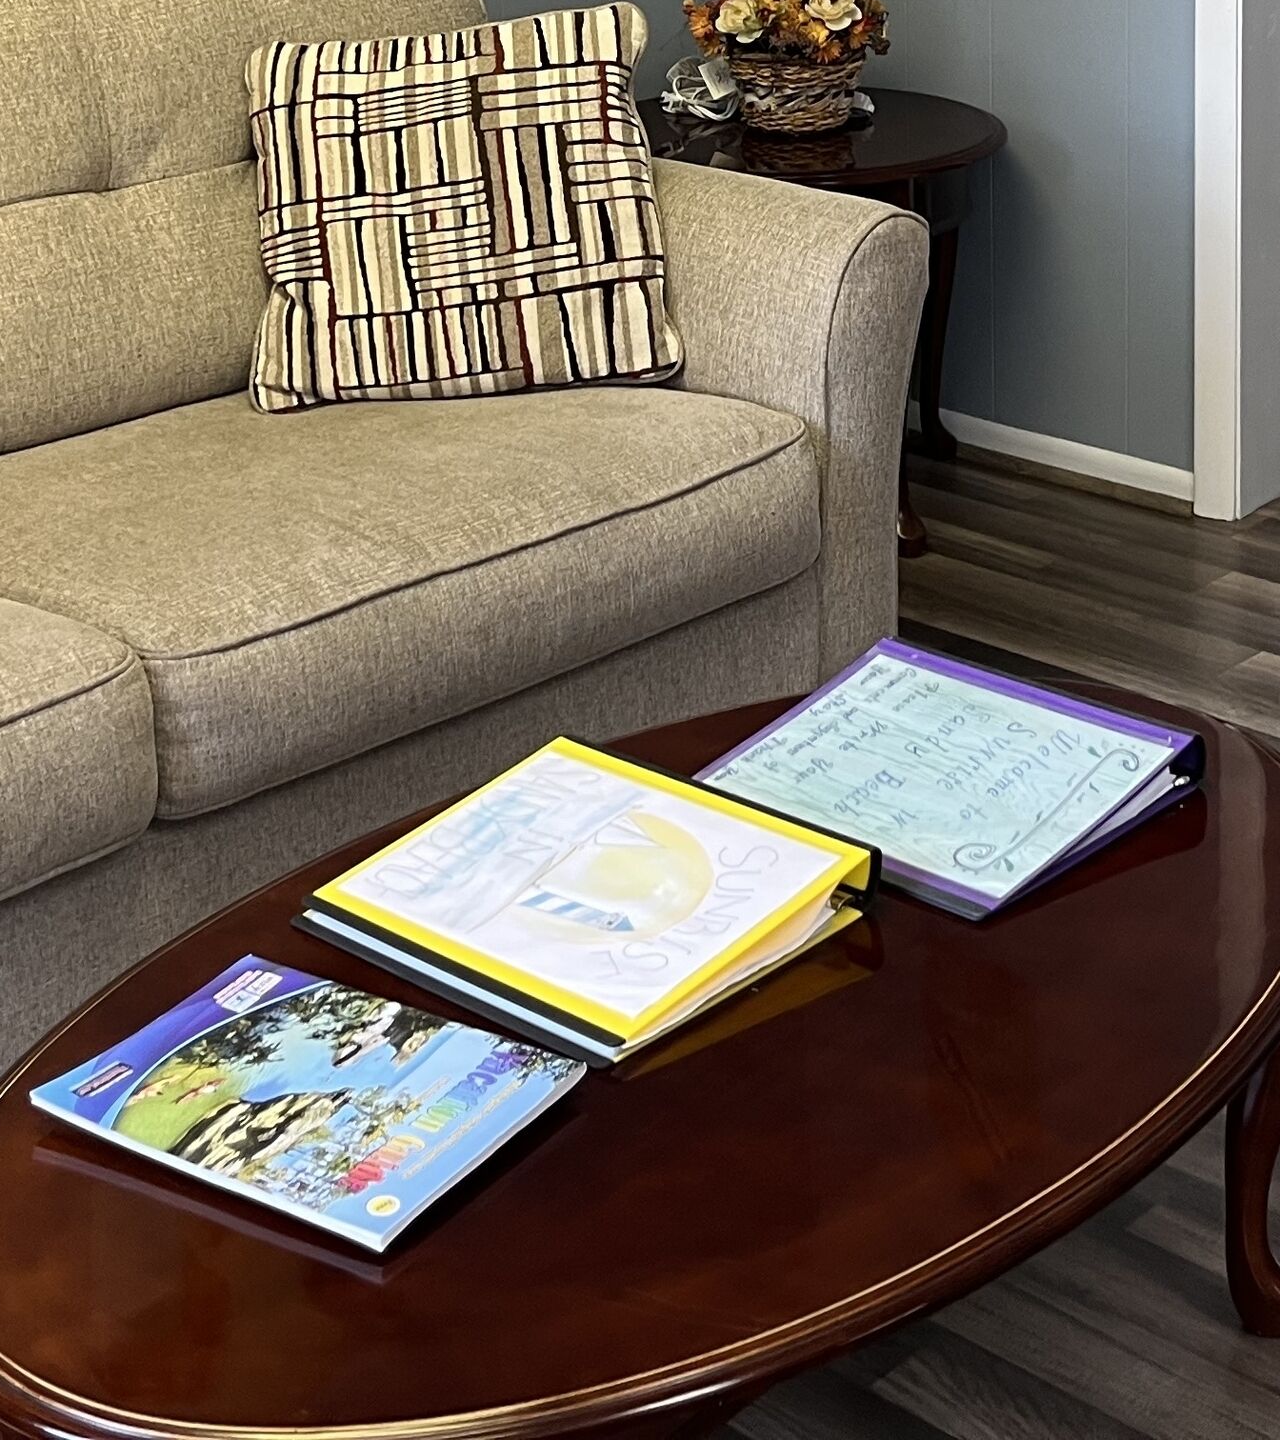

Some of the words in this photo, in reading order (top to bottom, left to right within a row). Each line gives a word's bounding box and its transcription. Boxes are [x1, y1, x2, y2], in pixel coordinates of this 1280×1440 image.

[837, 719, 888, 752] Write
[792, 757, 834, 785] Your
[985, 728, 1081, 798] Welcome
[832, 768, 907, 818] Beach
[958, 802, 988, 821] to
[508, 825, 566, 864] IN
[589, 844, 780, 980] SUNRISE
